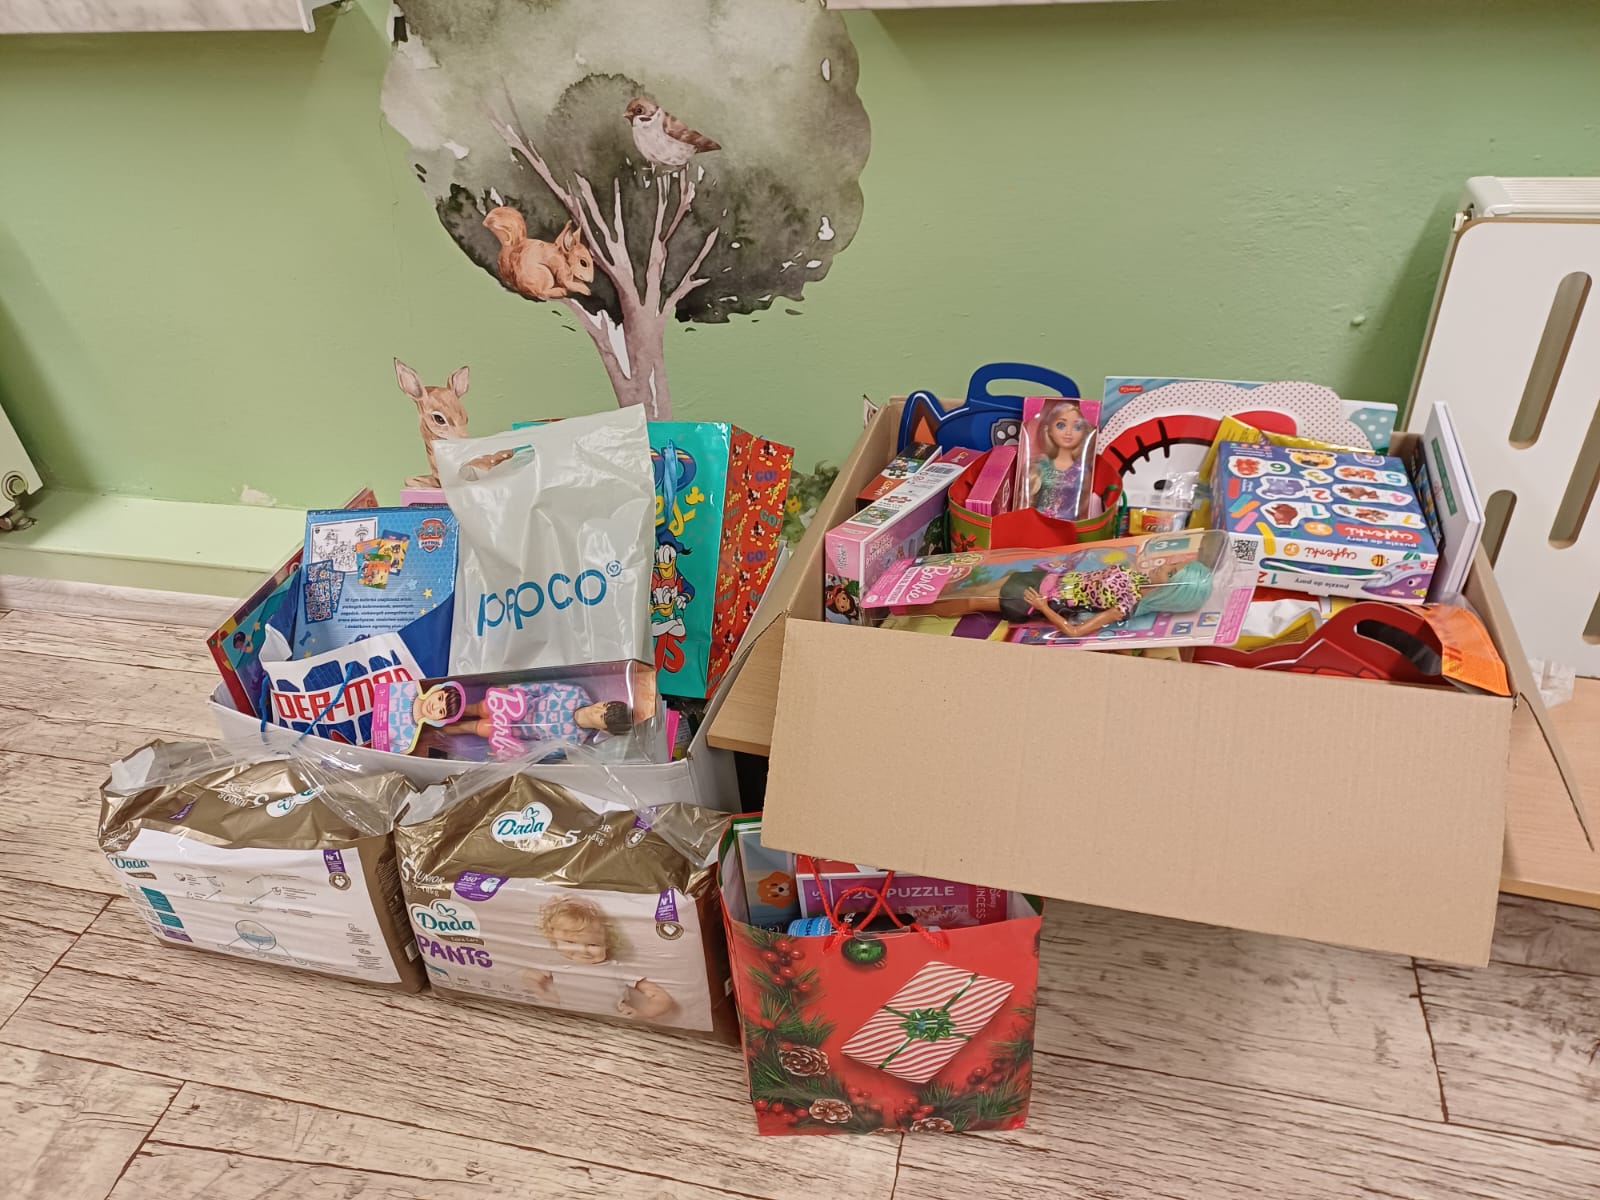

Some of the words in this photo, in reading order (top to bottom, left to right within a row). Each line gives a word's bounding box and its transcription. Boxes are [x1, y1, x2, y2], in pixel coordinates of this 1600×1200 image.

[905, 565, 954, 604] Barbie
[487, 689, 525, 758] Barb
[496, 816, 546, 836] Dada
[886, 885, 956, 899] PUZZLE
[416, 912, 477, 932] Dada
[416, 934, 493, 969] PANTS
